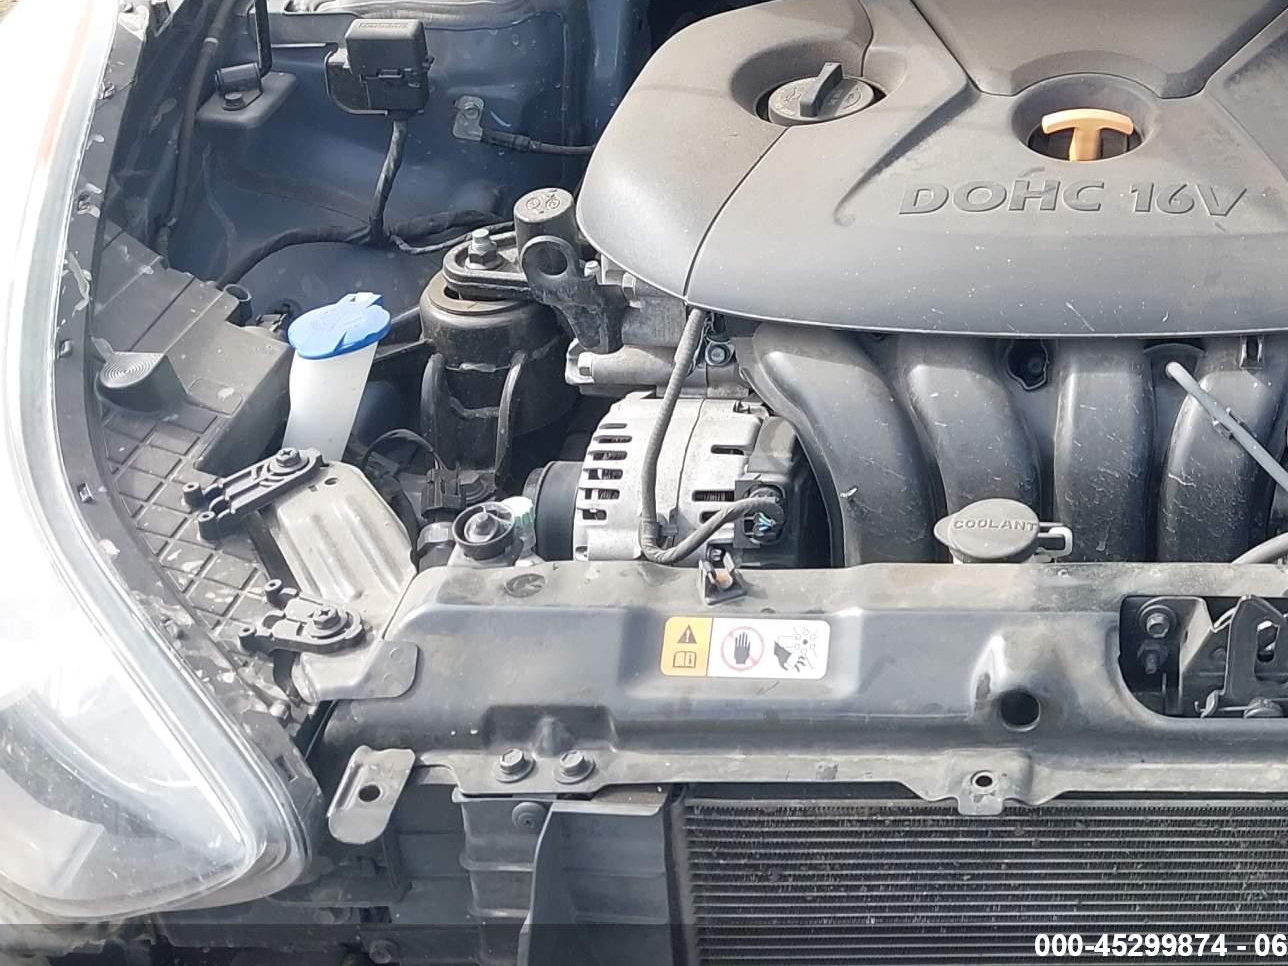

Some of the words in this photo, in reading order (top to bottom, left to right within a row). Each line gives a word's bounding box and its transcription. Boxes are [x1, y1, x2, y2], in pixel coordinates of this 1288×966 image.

[898, 179, 1105, 215] DOHC
[1130, 182, 1248, 217] 16V
[953, 519, 1038, 532] COOLANT
